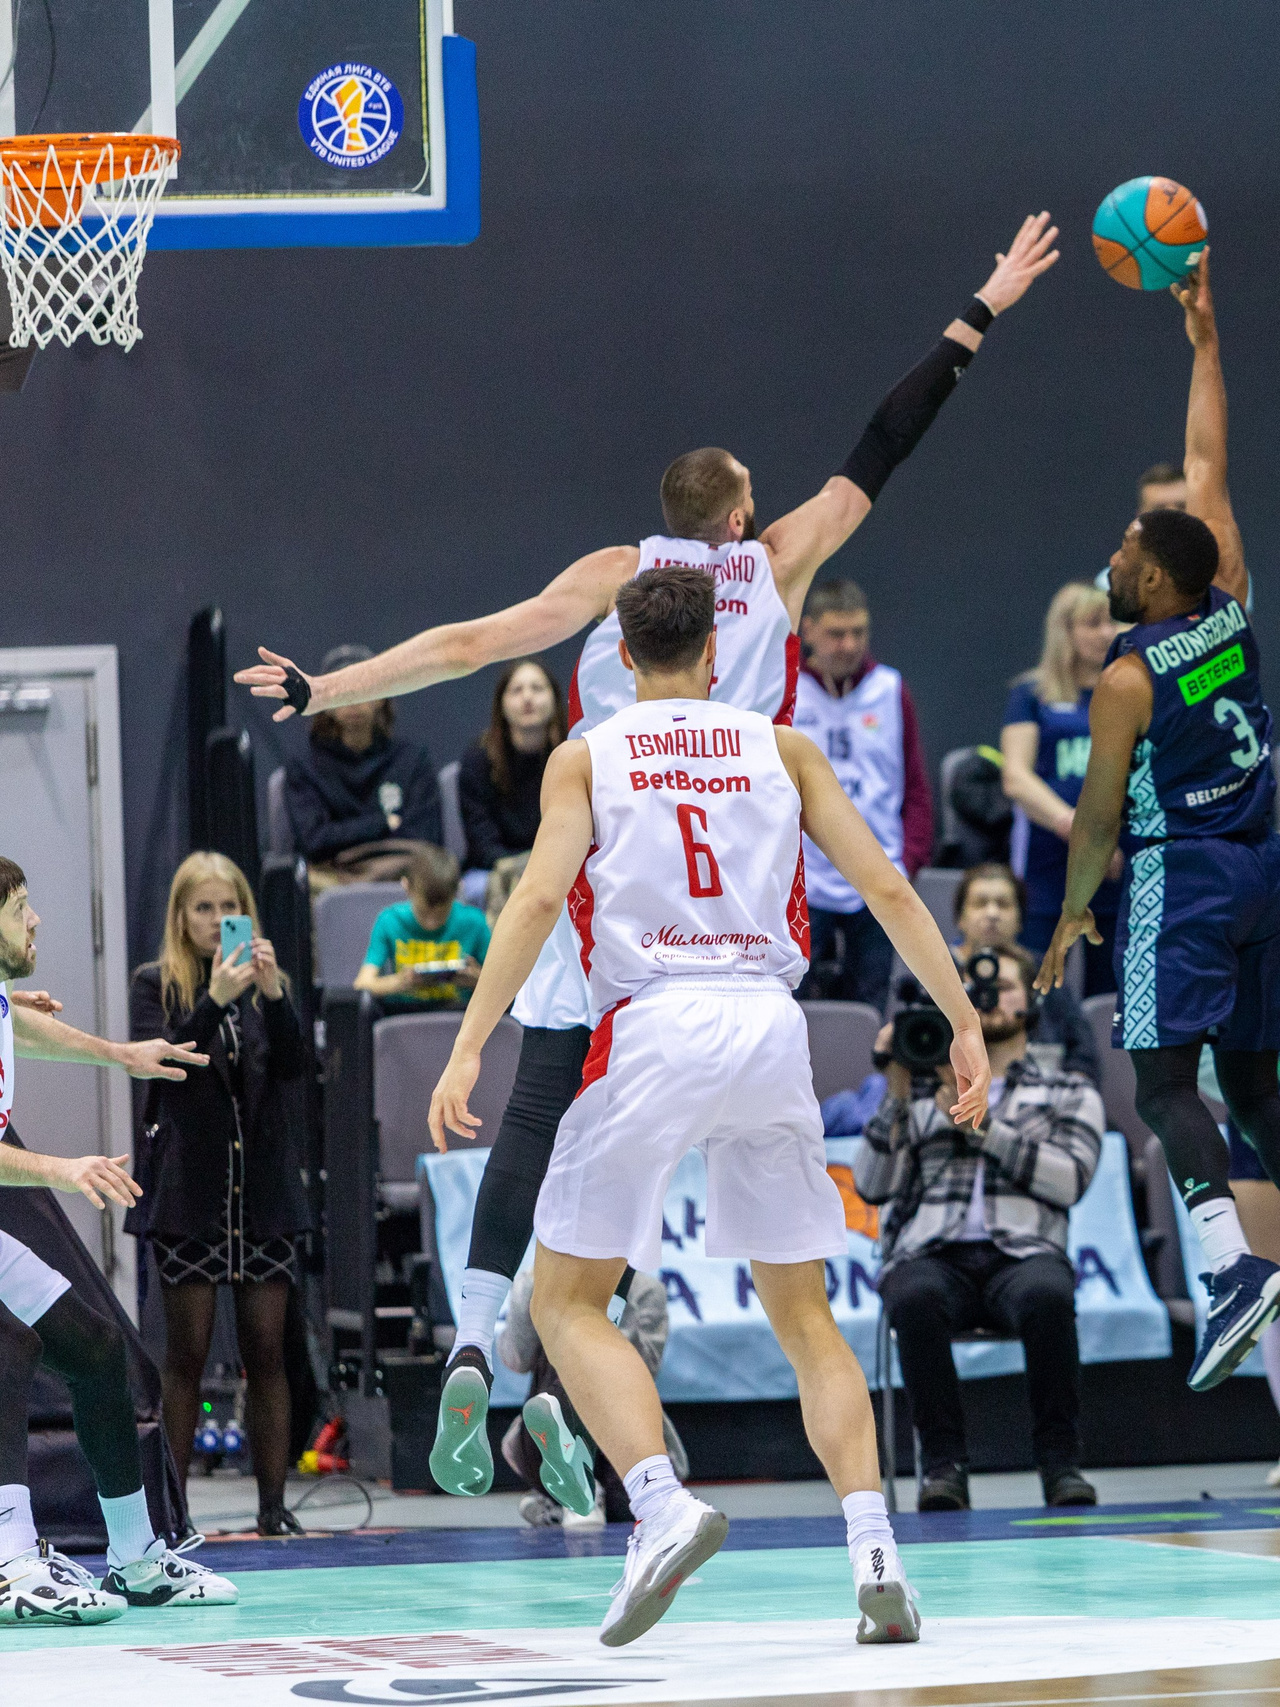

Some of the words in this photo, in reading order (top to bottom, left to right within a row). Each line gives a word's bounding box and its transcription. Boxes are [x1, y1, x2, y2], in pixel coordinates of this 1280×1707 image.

[304, 65, 342, 101] ЕДИНАЯ
[344, 64, 373, 79] ЛИГА
[311, 137, 328, 158] VTB
[327, 152, 366, 168] UNITED
[365, 129, 399, 164] LEAGUE
[1145, 600, 1247, 675] OGUNGBEMI
[1187, 653, 1241, 697] BETERA
[625, 728, 742, 760] ISMAILOV
[1213, 696, 1261, 769] 3
[629, 769, 751, 794] BetBoom
[676, 803, 724, 898] 6
